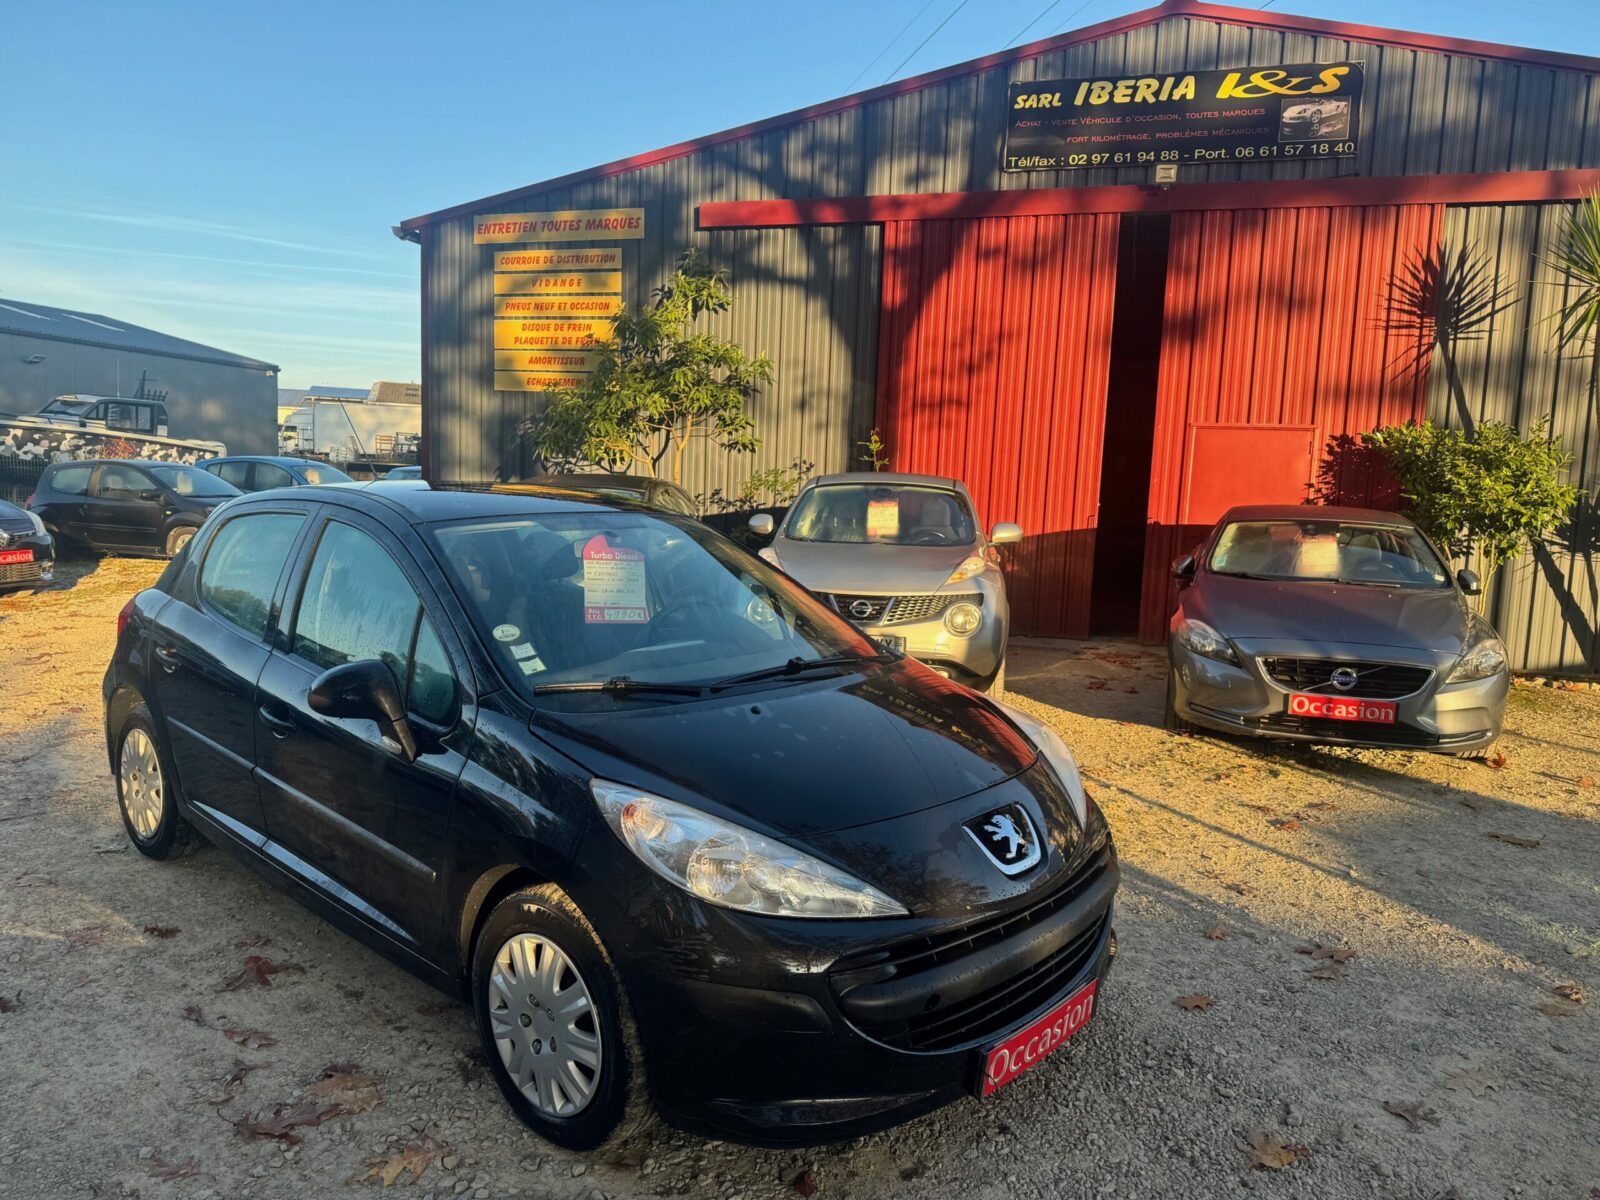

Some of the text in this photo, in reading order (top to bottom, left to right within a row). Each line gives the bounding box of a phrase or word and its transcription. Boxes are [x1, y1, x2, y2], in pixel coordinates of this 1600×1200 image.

[1014, 93, 1062, 109] SARL
[1073, 75, 1195, 106] IBERIA
[1015, 120, 1041, 128] ACHAT
[1051, 118, 1078, 126] VENTE
[1080, 115, 1122, 125] VÉHICULE
[1185, 111, 1219, 119] TOUTES
[1222, 108, 1266, 118] MARQUES
[1066, 135, 1089, 143] FORT
[1068, 154, 1087, 165] 02
[1091, 153, 1110, 164] 97
[1114, 152, 1131, 162] 61
[1137, 151, 1155, 162] 94
[1160, 150, 1179, 160] 88
[1194, 148, 1230, 160] Port.
[1235, 146, 1255, 157] 06
[1260, 145, 1278, 156] 61
[1284, 144, 1304, 155] 57
[1311, 143, 1329, 154] 18
[1334, 142, 1354, 153] 40
[477, 217, 641, 235] ENTRETIEN TOUTES MARQUES
[500, 254, 616, 265] COURROIE DE DISTRIBUTION
[532, 278, 583, 288] VIDANGE
[505, 302, 610, 311] PNEUS NEUF ET OCCASION
[521, 323, 592, 332] DISQUE DE FREIN
[514, 336, 560, 345] PLAQUETTE
[562, 336, 573, 345] DE
[528, 356, 585, 365] AMORTISSEUR
[0, 552, 32, 562] casion
[590, 551, 638, 560] Turbo Diesel
[1292, 696, 1394, 721] Occasion
[988, 994, 1094, 1086] Occasion
